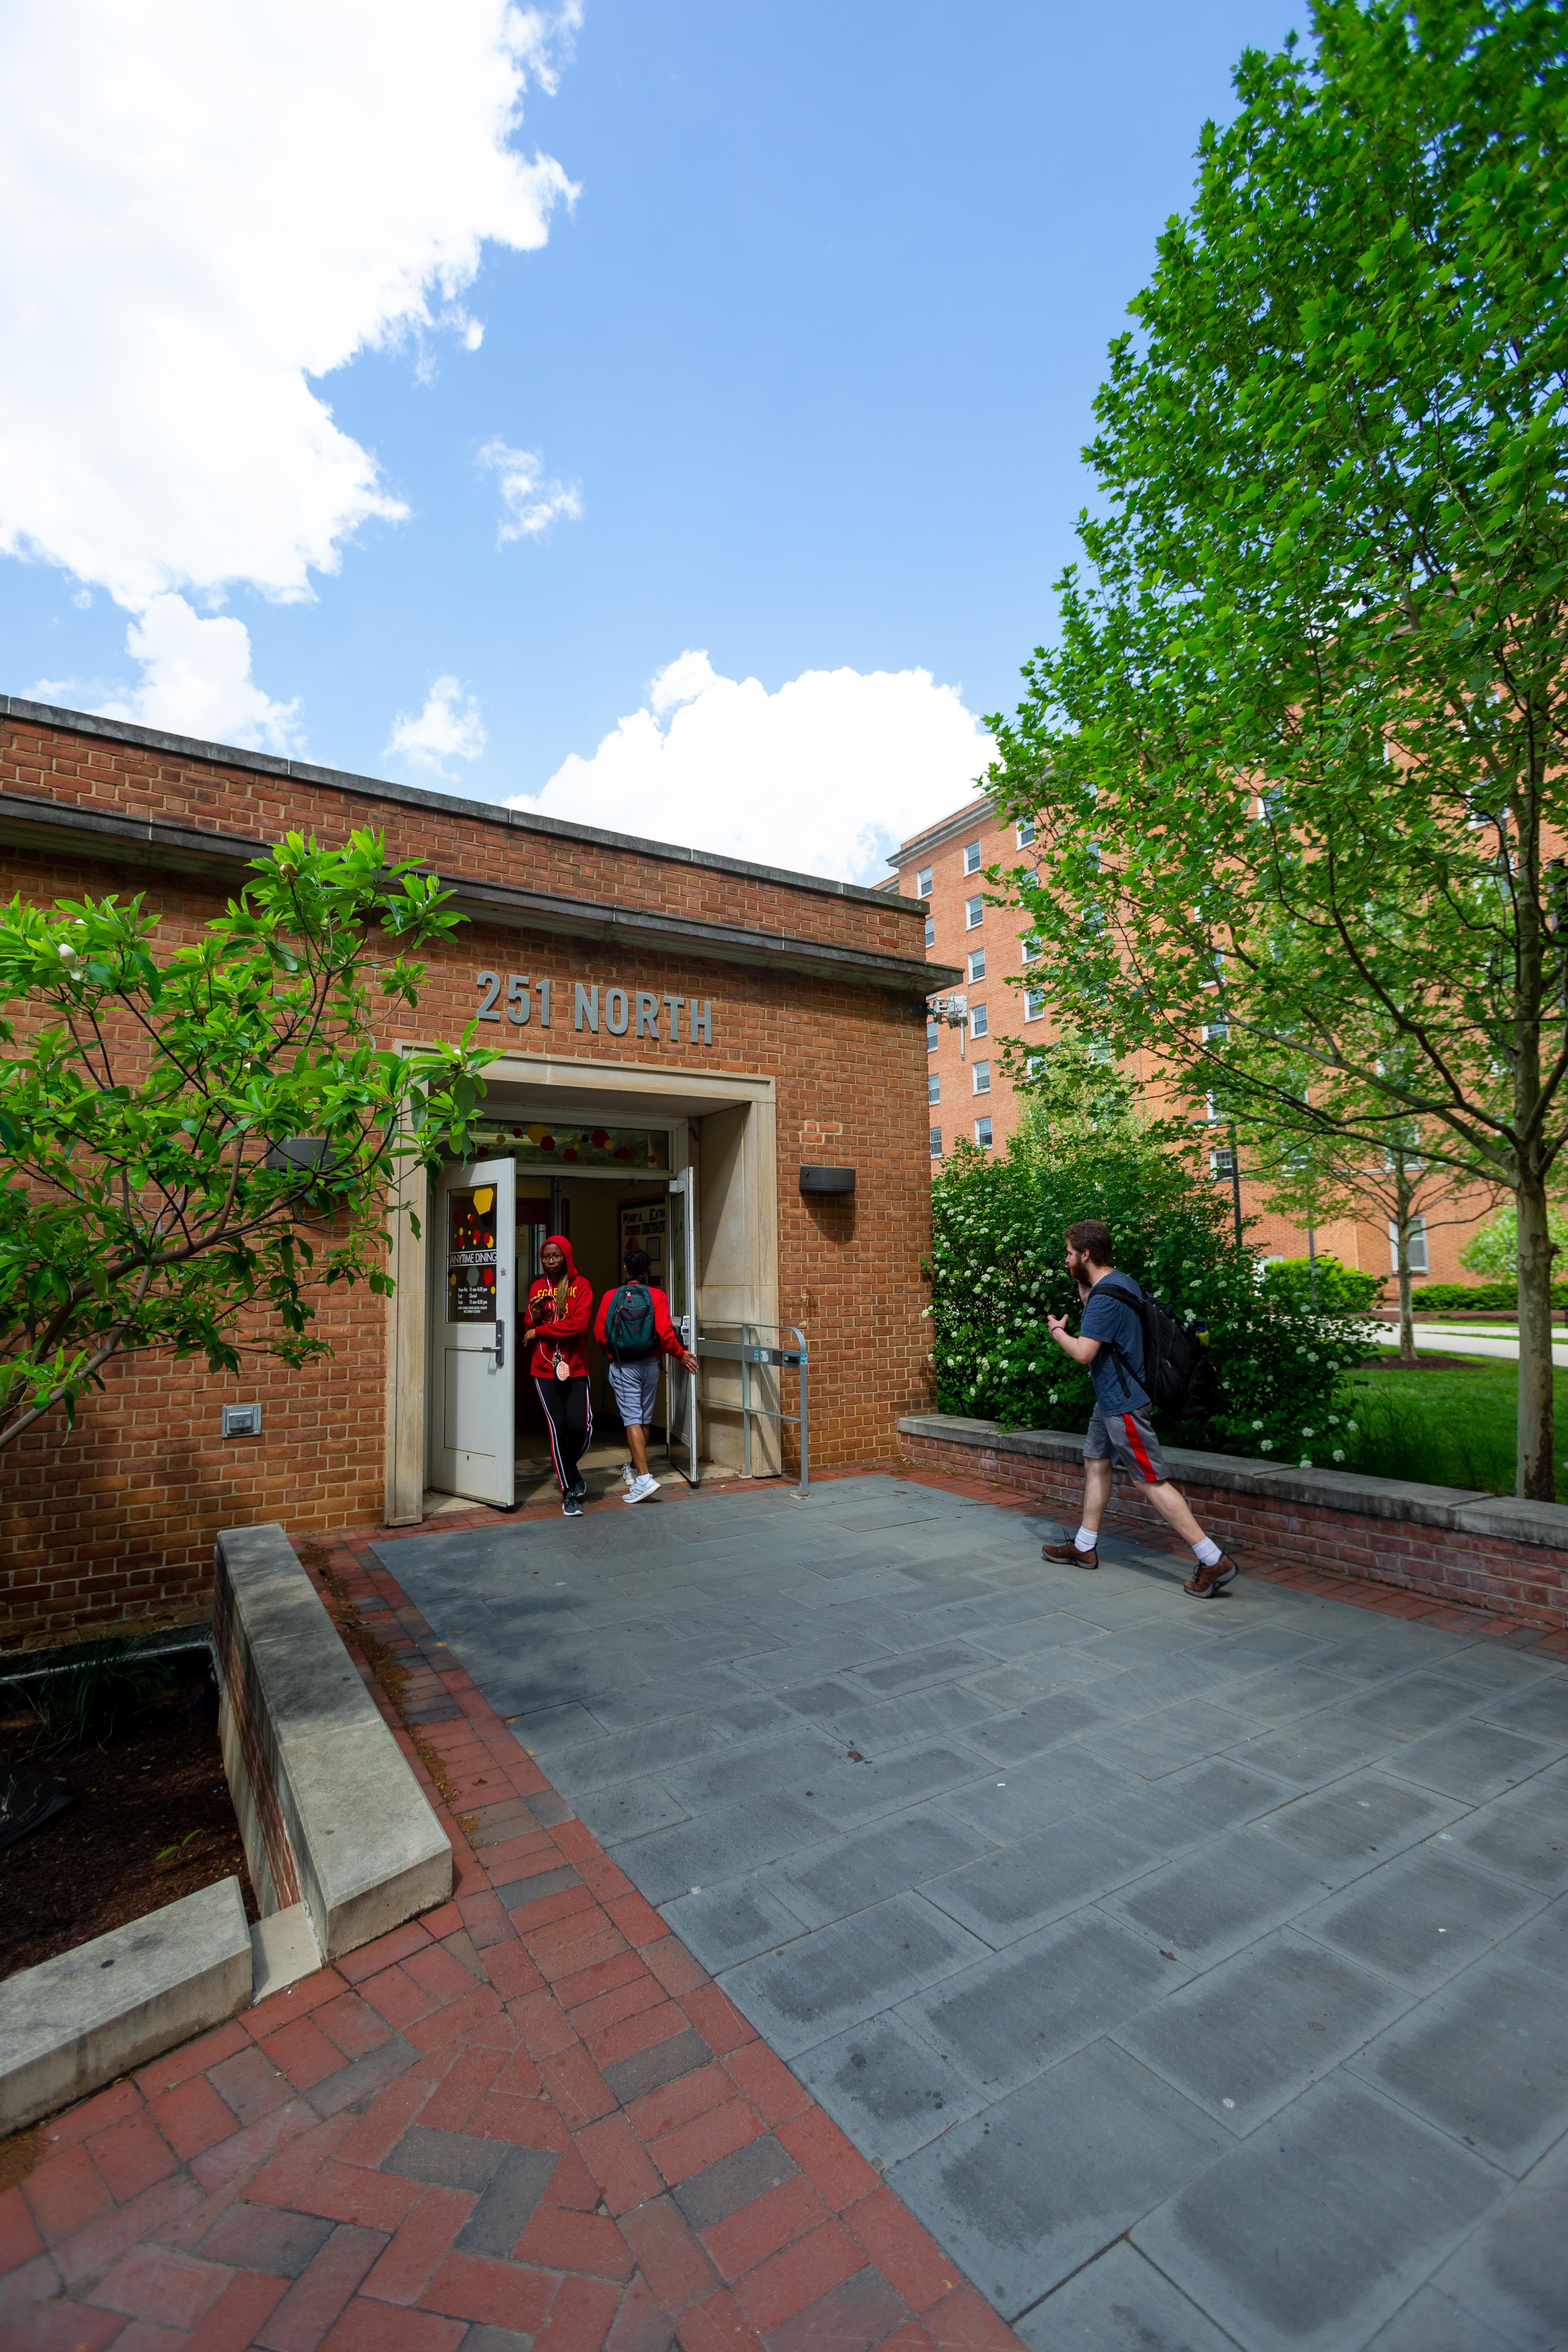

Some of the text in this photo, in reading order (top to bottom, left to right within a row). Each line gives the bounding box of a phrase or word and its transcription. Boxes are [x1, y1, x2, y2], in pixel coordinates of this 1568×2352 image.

[476, 971, 712, 1045] 251 NORTH
[450, 1252, 497, 1264] ANYTIME DINING
